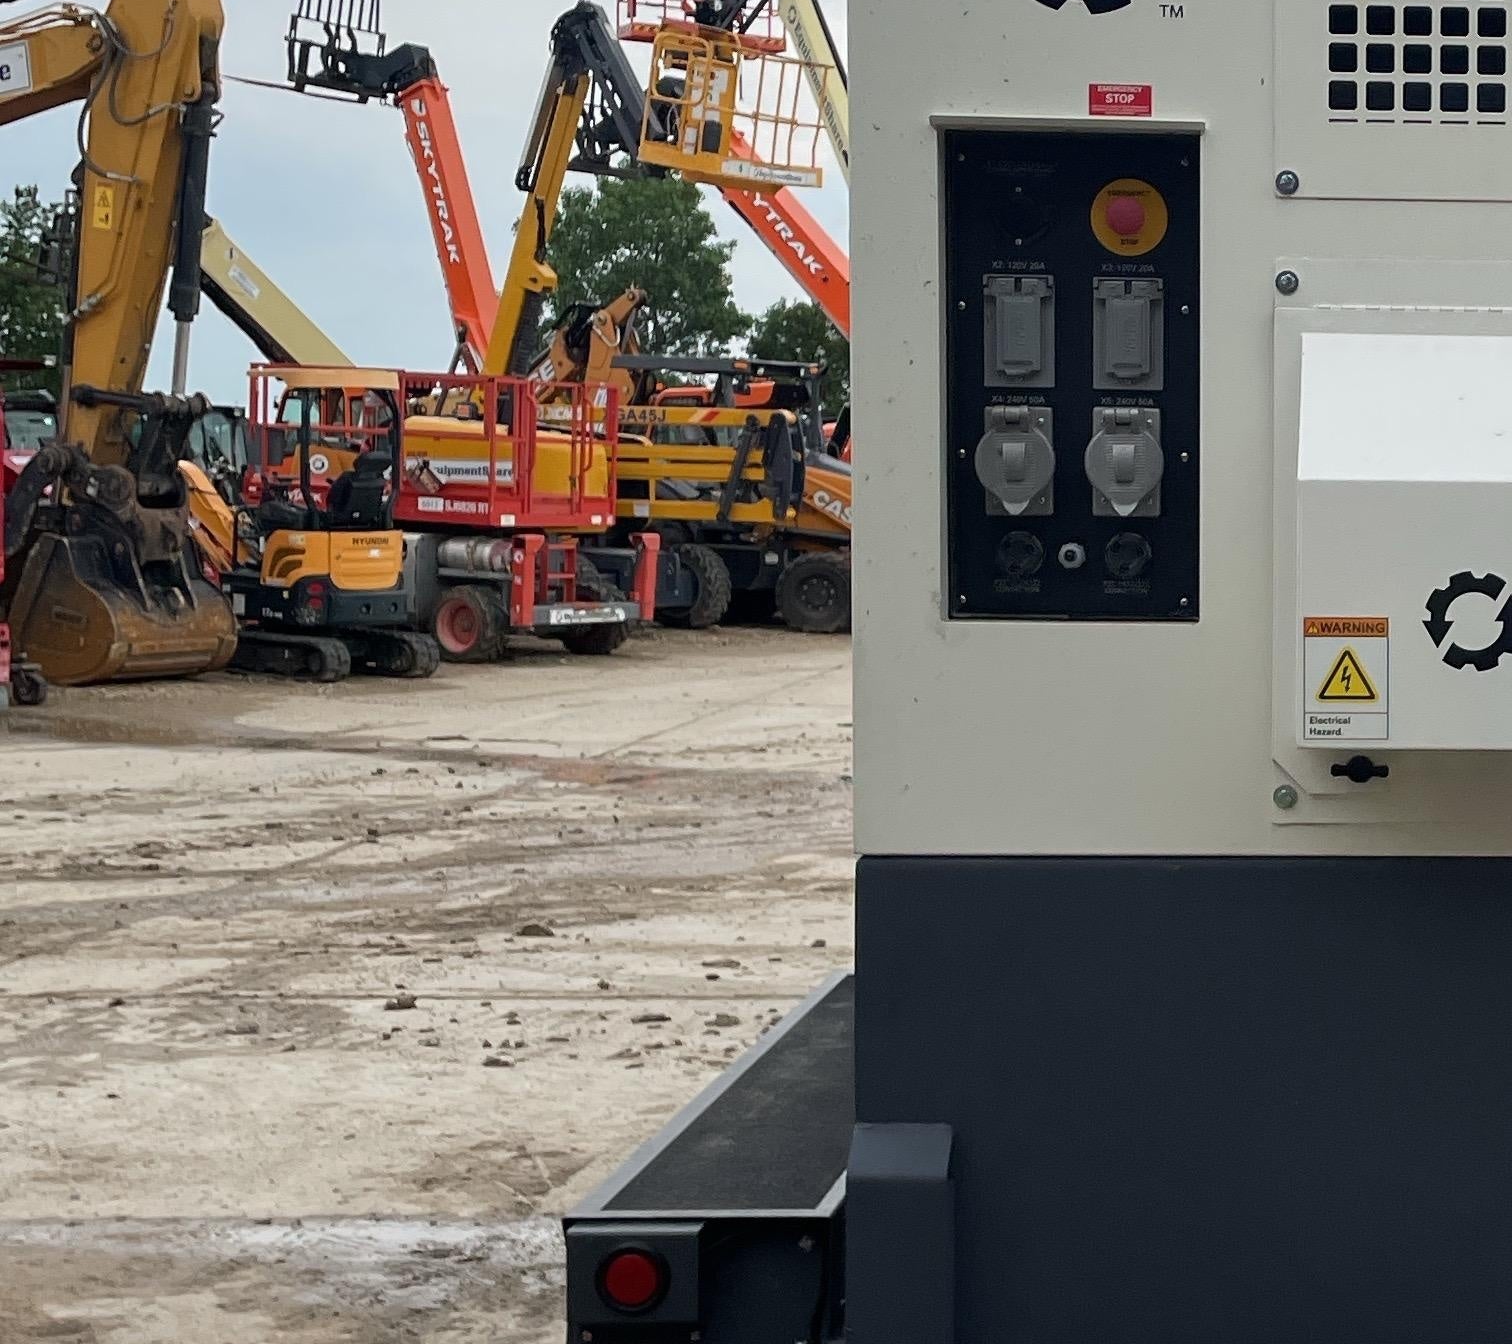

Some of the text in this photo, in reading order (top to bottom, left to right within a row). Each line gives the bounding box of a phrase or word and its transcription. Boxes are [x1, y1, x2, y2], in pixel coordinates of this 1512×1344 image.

[1159, 5, 1184, 19] TM
[1105, 93, 1135, 104] STOP
[416, 121, 461, 265] SKYTRAK
[352, 537, 388, 545] HYUNDAI
[1320, 622, 1386, 634] WARNING
[1309, 715, 1351, 725] Electrical
